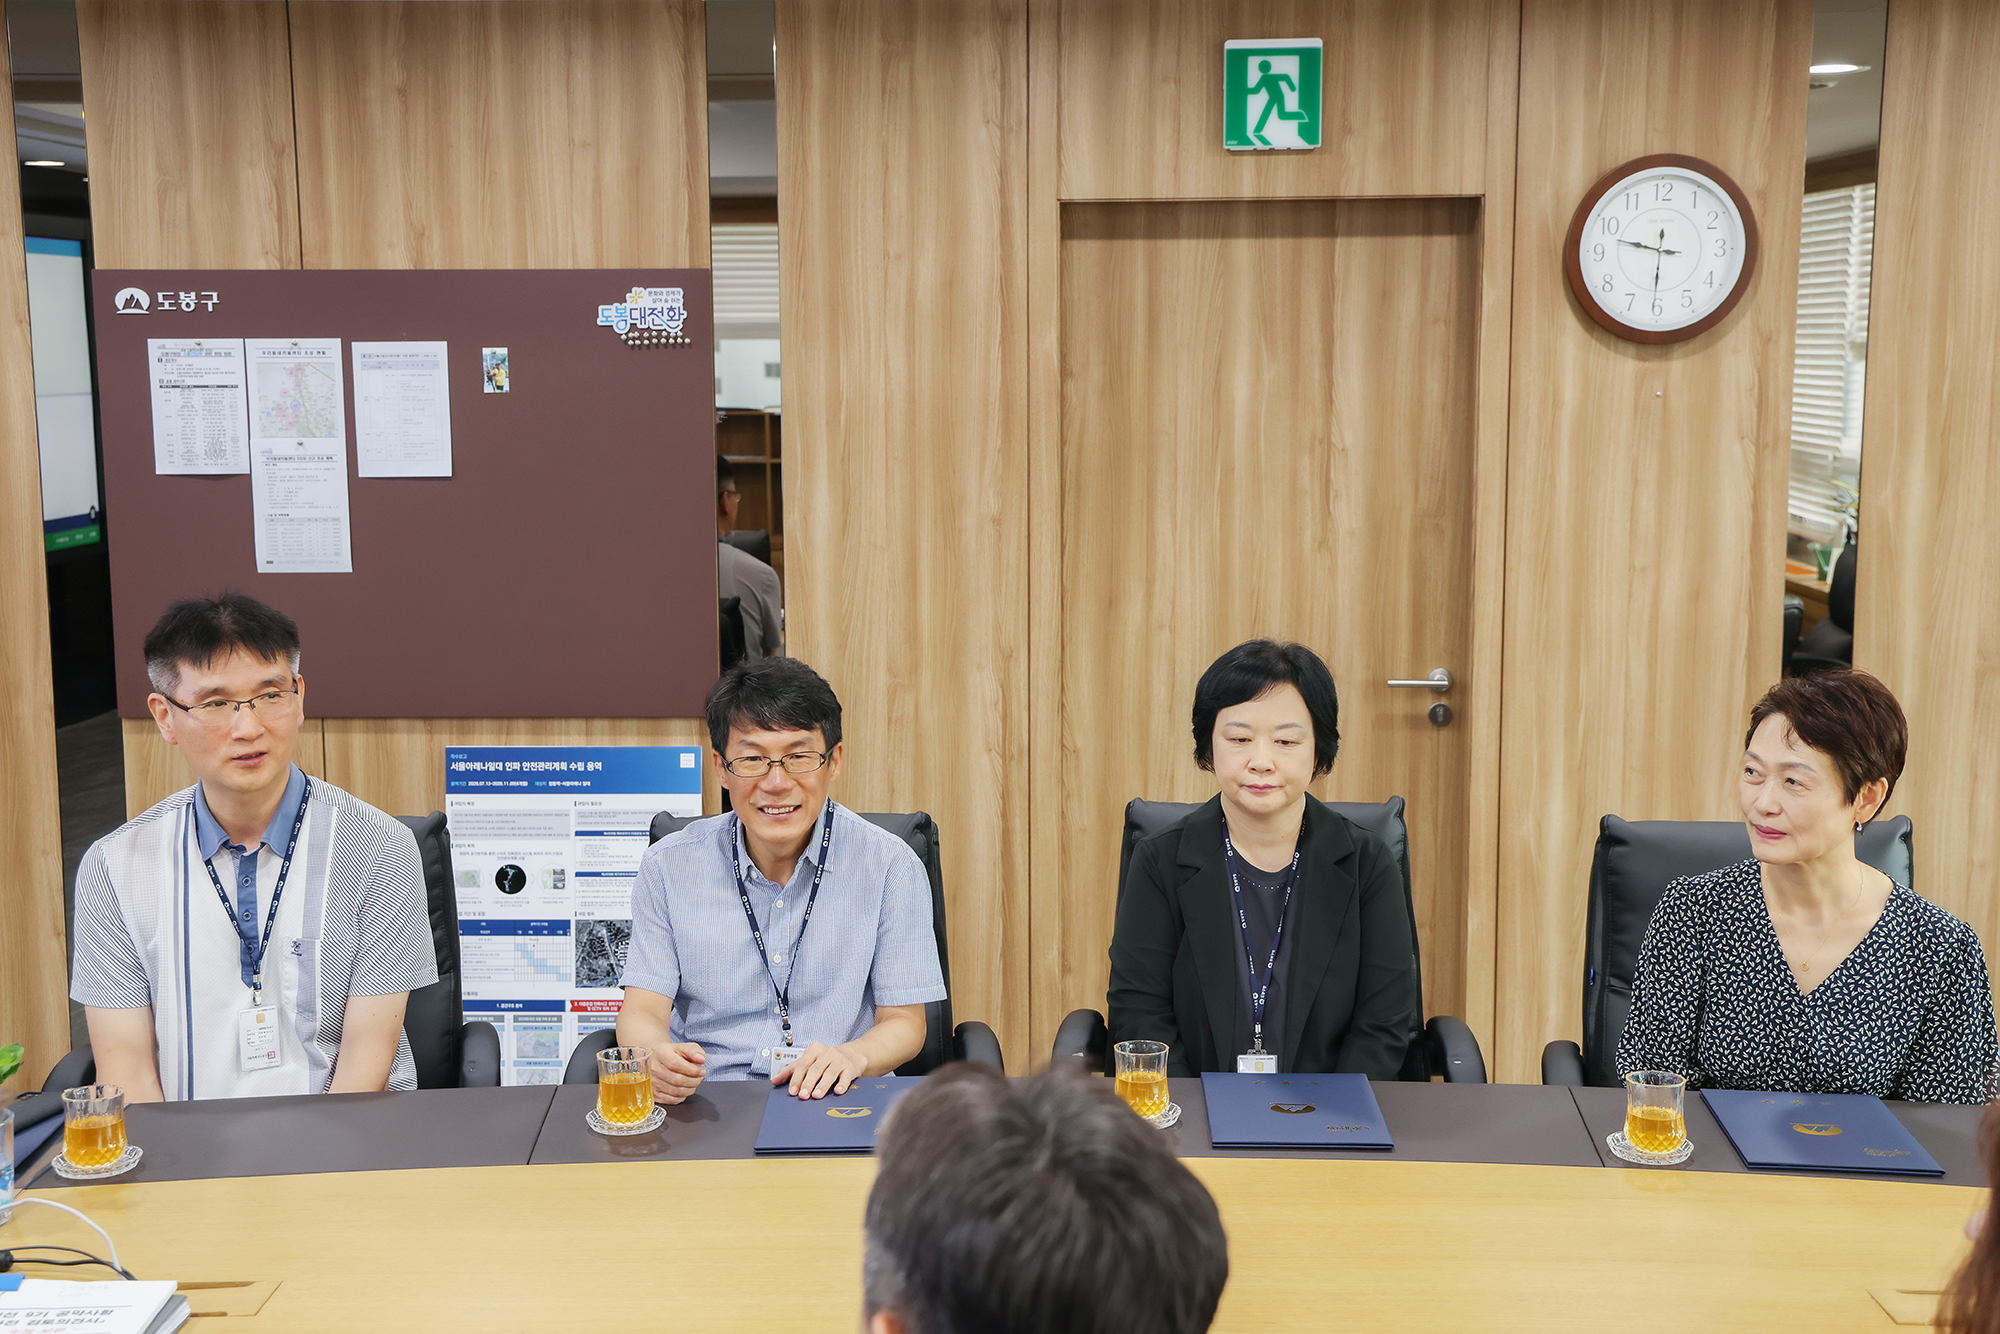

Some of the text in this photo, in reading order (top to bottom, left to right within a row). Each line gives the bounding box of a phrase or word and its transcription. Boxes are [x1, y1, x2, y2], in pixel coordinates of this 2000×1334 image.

[1653, 182, 1674, 201] 12
[1690, 190, 1698, 209] 1
[1624, 192, 1640, 211] 11
[1599, 216, 1620, 236] 10
[1706, 210, 1719, 230] 2
[1593, 242, 1605, 262] 9
[1714, 238, 1726, 258] 3
[1601, 273, 1614, 293] 8
[1702, 270, 1714, 289] 4
[156, 291, 220, 312] 도봉구
[1624, 293, 1636, 312] 7
[1651, 297, 1663, 317] 6
[1680, 289, 1692, 308] 5
[450, 762, 602, 771] 서울아레나일대 인파 안전관리계획 수립 용역
[56, 1309, 114, 1317] 공약사항
